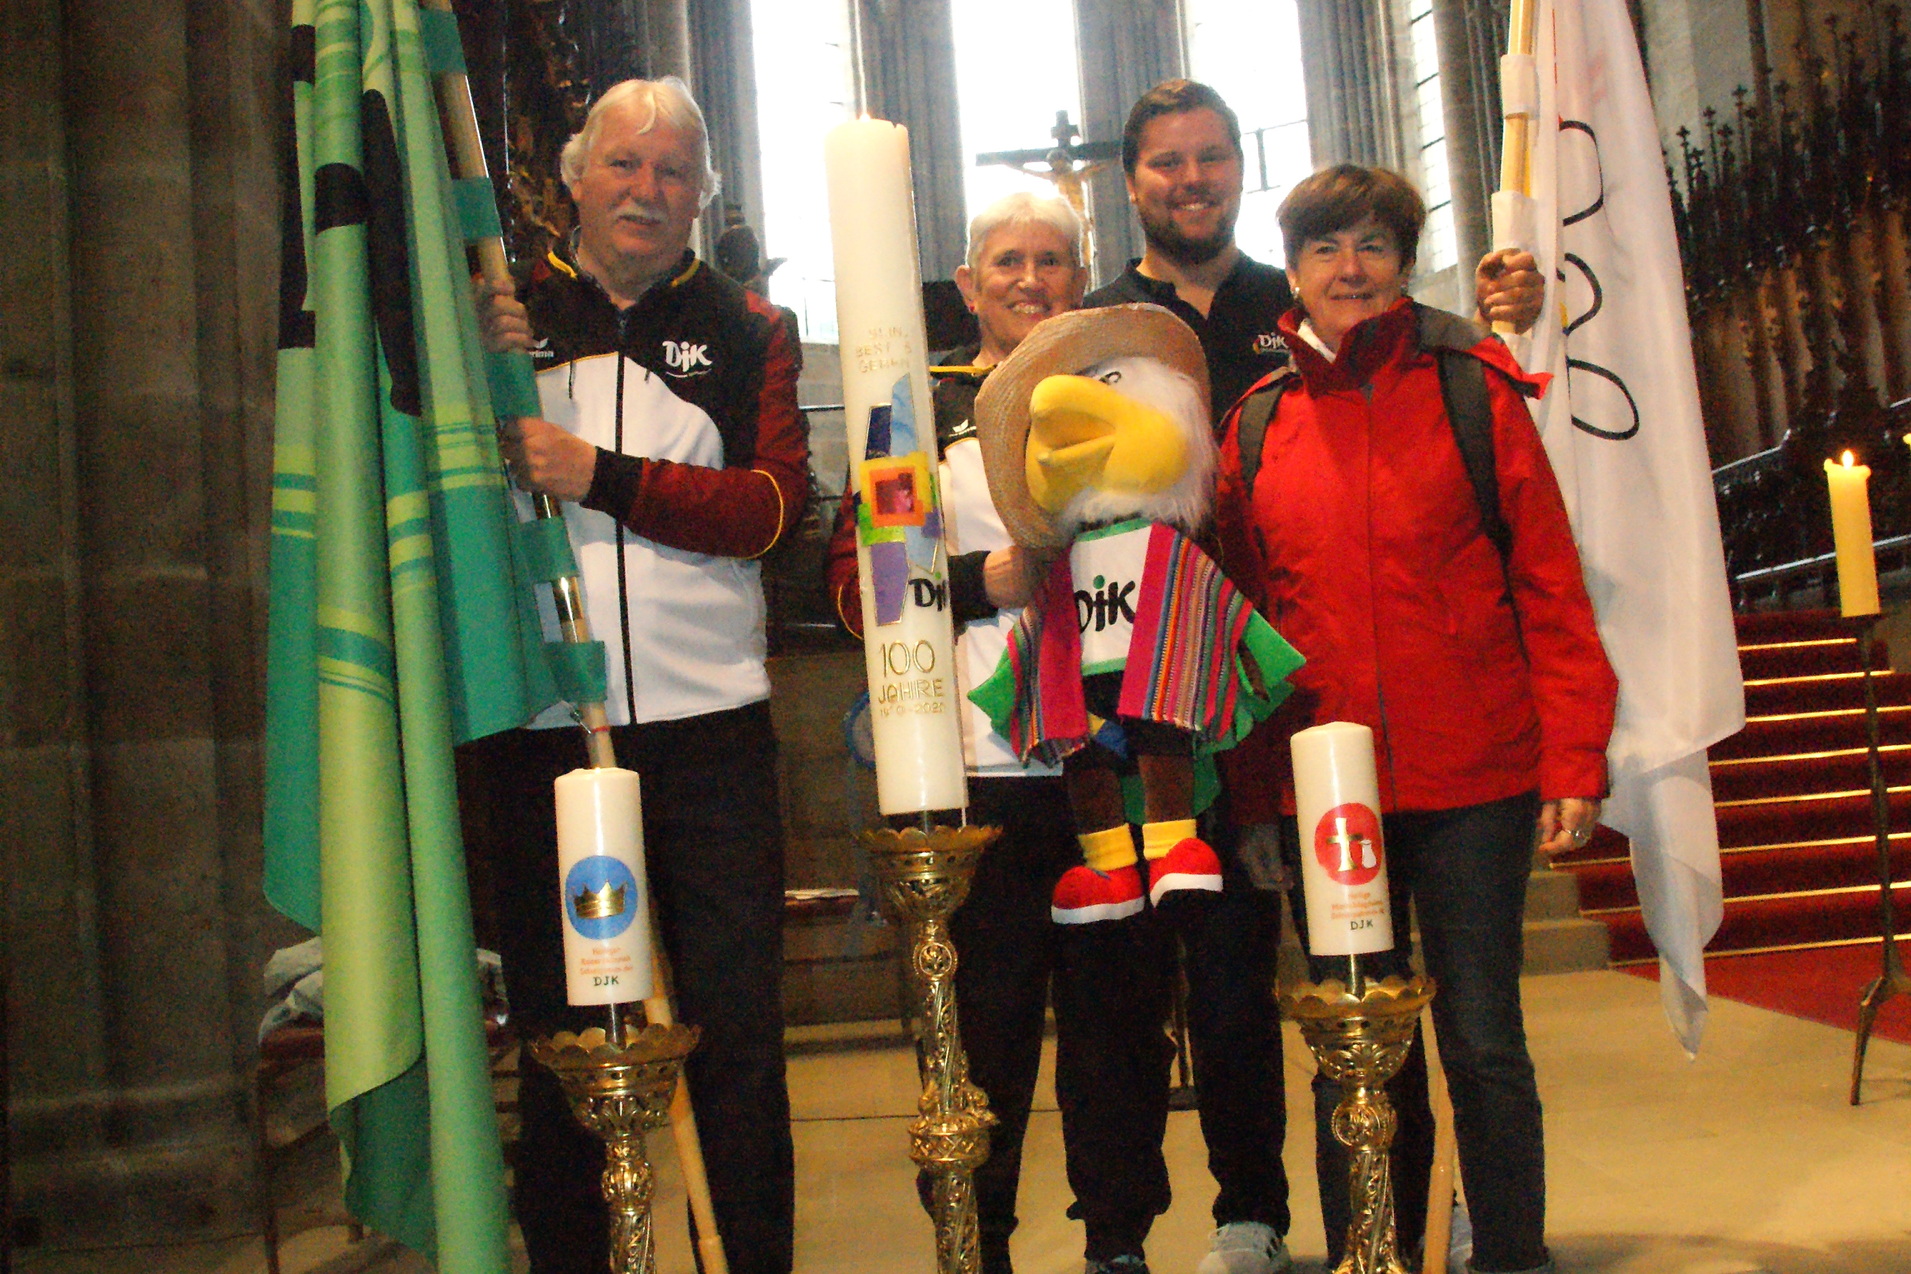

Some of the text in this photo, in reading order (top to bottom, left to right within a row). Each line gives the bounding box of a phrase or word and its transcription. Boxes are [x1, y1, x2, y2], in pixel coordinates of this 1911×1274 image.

[879, 639, 935, 678] 100
[1350, 919, 1373, 930] DJK
[593, 975, 619, 986] DJK
